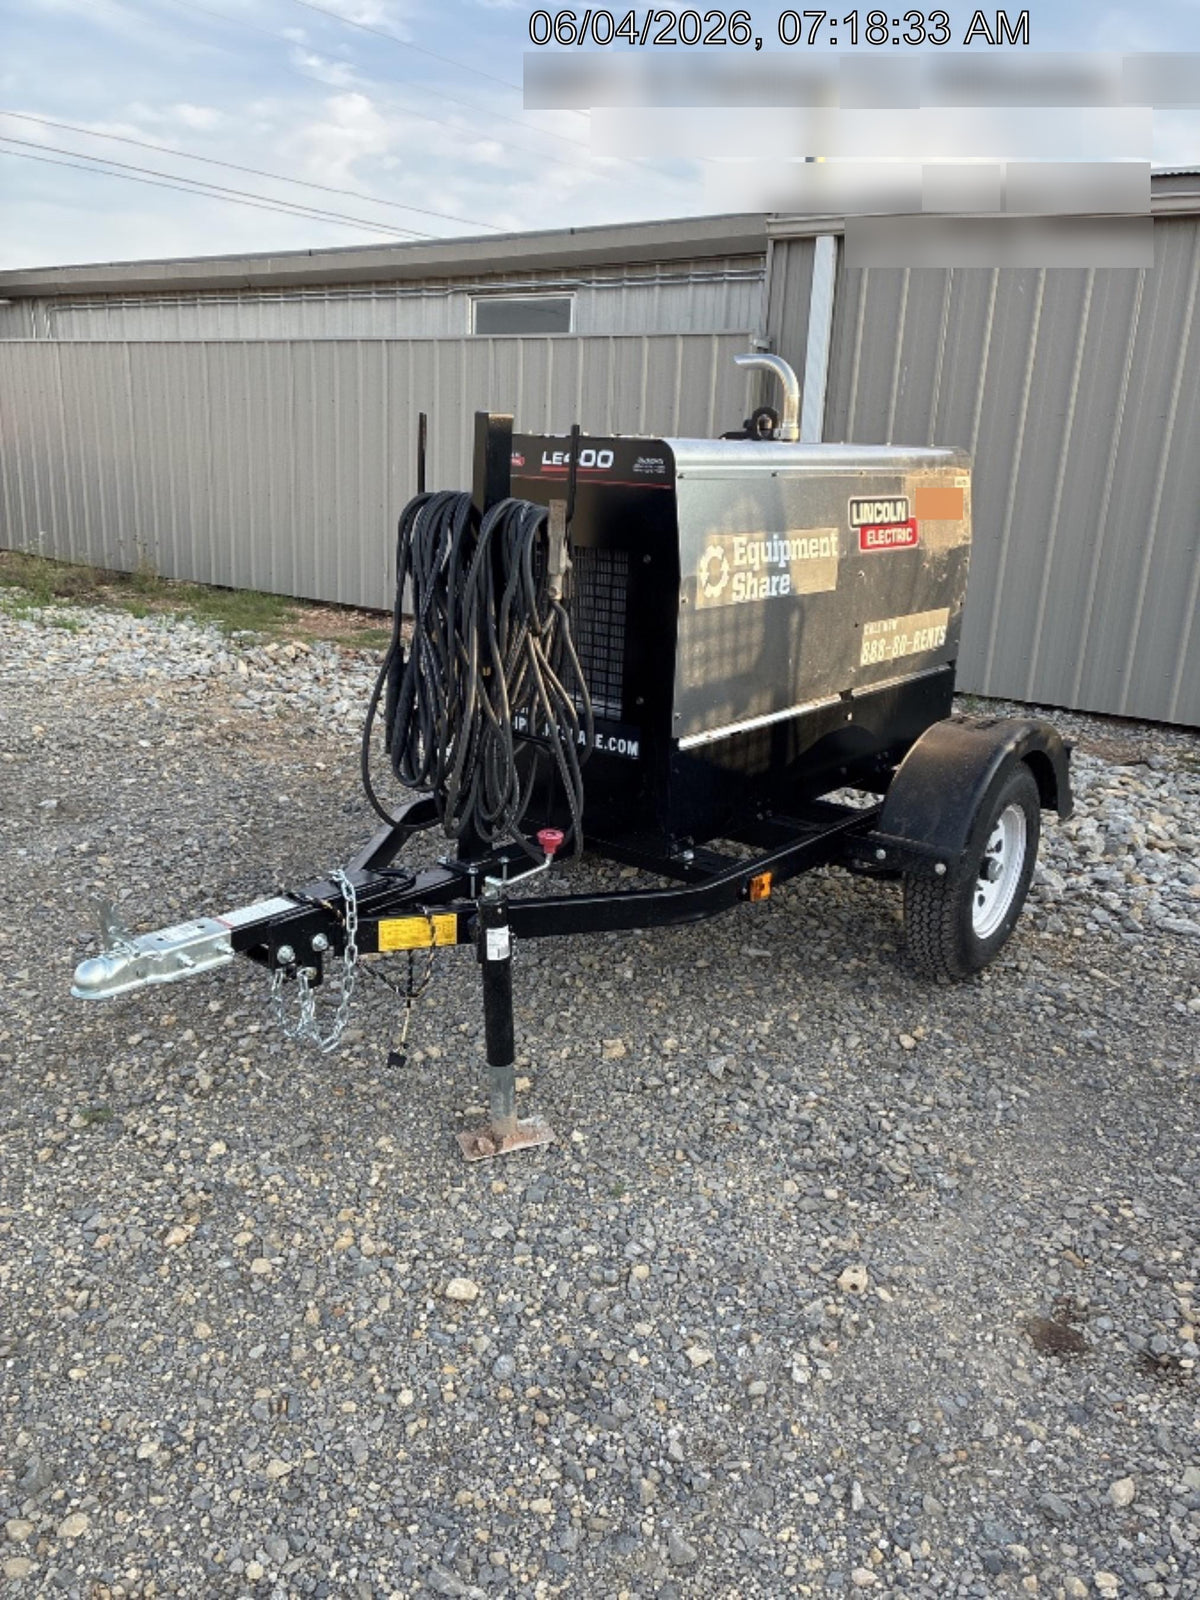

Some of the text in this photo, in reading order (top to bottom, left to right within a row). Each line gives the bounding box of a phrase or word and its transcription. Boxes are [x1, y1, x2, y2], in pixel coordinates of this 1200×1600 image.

[851, 501, 907, 526] LINCOLN
[866, 527, 914, 546] ELECTRIC
[732, 532, 839, 572] Equipment
[731, 572, 792, 604] Share
